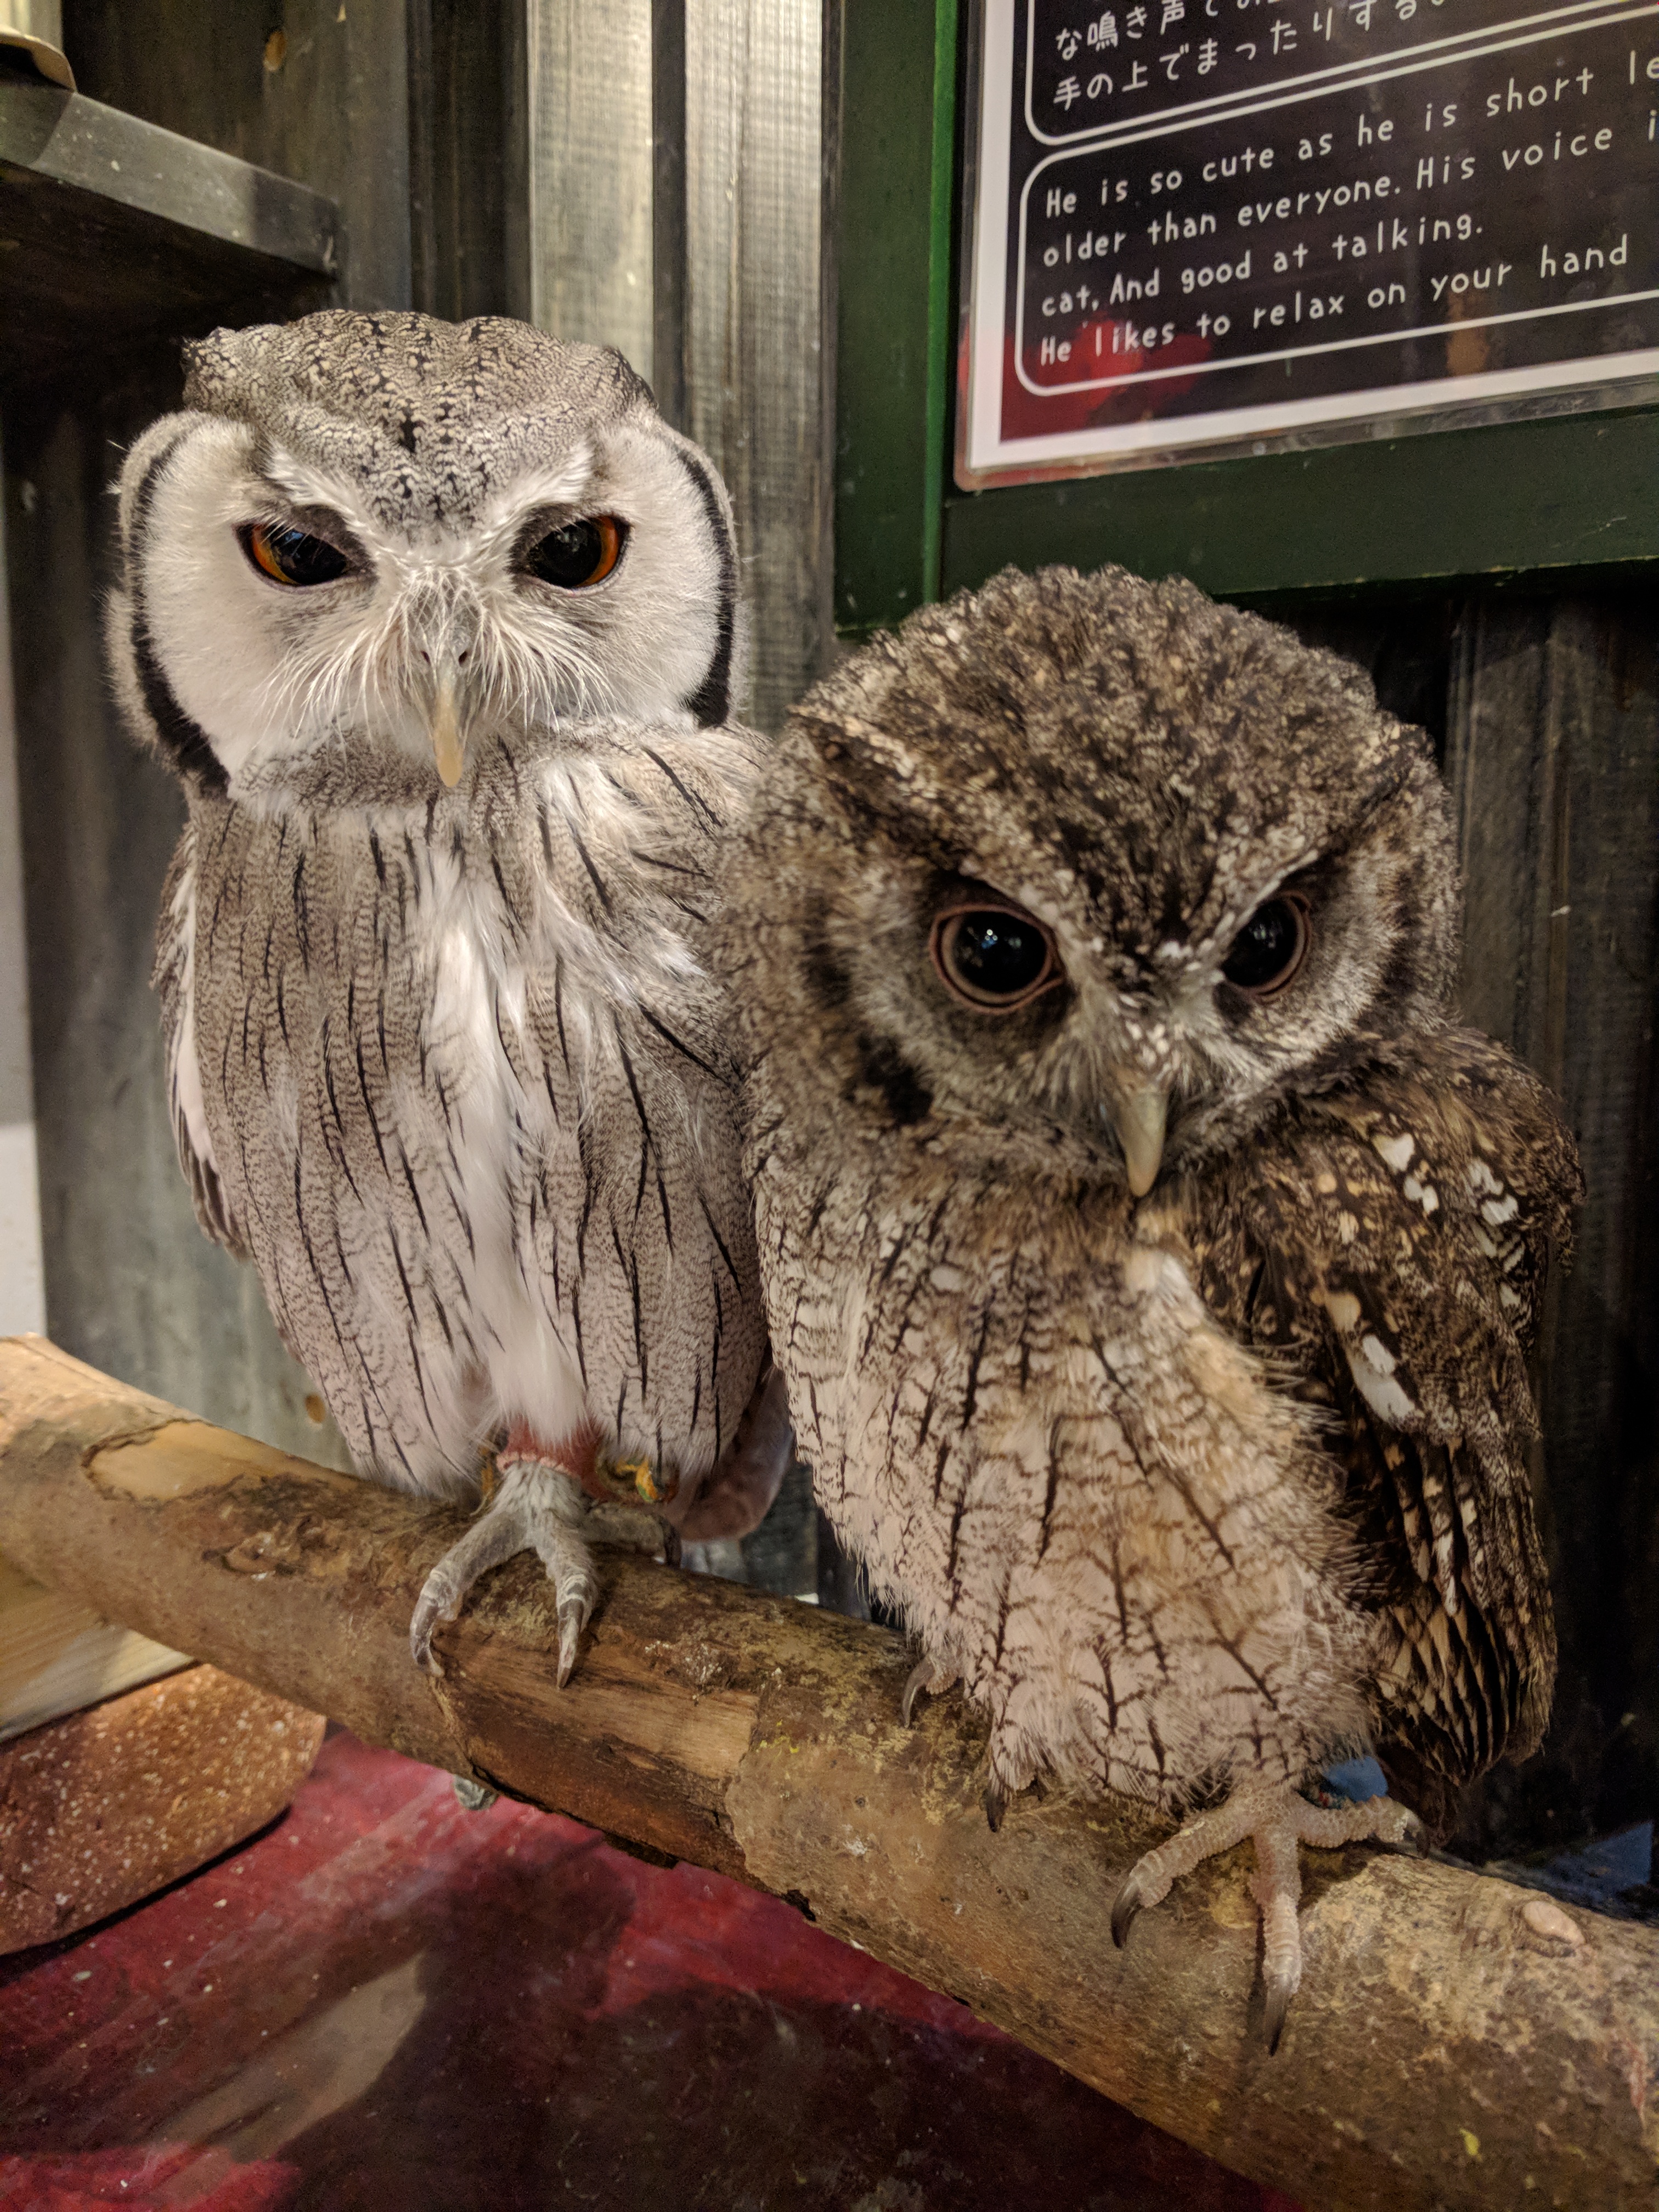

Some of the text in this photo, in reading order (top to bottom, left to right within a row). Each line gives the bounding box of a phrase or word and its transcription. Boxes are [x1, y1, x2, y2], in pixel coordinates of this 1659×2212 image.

[1044, 226, 1126, 267] older
[1148, 213, 1216, 245] than
[1238, 176, 1401, 228] everyone.
[1417, 157, 1475, 190] His
[1502, 128, 1612, 171] voice
[1046, 188, 1076, 218] He
[1101, 179, 1128, 205] is
[1150, 170, 1182, 194] so
[1203, 145, 1274, 182] cute
[1298, 133, 1332, 161] as
[1358, 114, 1393, 146] he
[1425, 103, 1457, 131] is
[1487, 68, 1593, 117] short
[1041, 234, 1628, 365] He likes to relax on your hand
[1110, 274, 1159, 304] And
[1181, 252, 1250, 298] good
[1273, 244, 1308, 272] at
[1332, 210, 1482, 261] talking.
